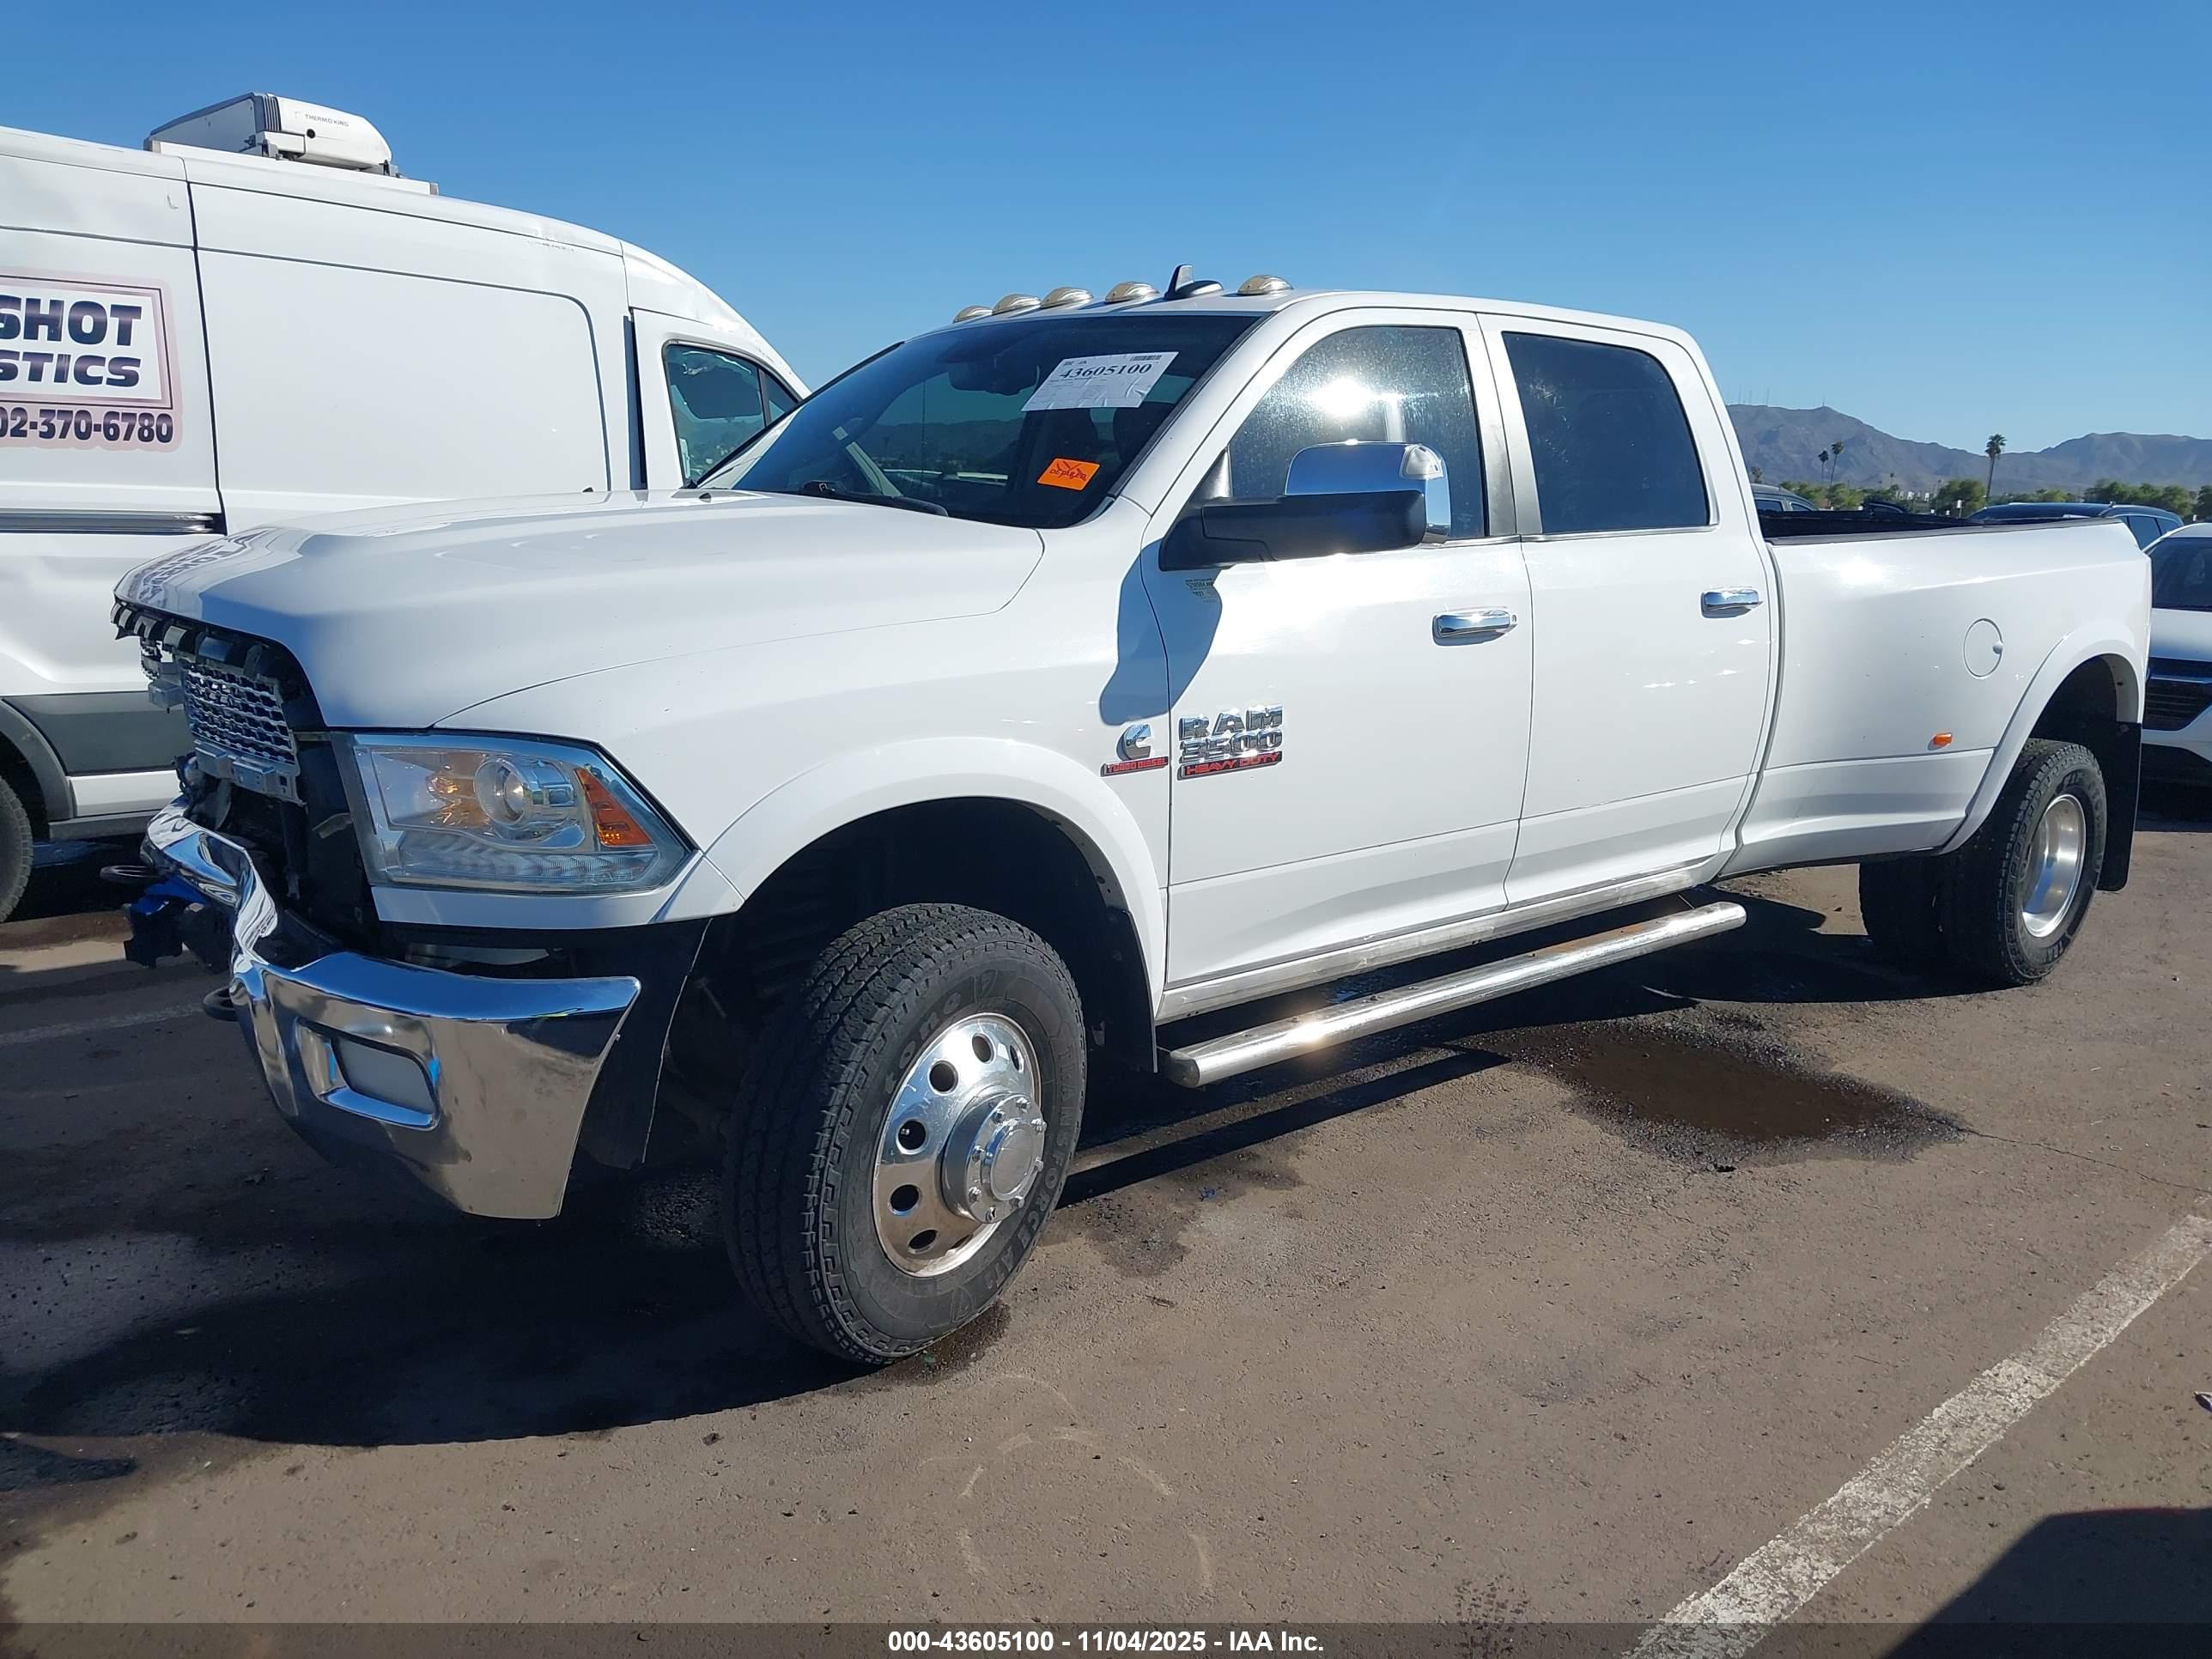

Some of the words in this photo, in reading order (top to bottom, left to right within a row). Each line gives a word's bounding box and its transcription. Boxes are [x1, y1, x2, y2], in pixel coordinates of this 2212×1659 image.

[305, 113, 332, 125] THERMO
[333, 119, 349, 128] KING
[1058, 363, 1152, 379] 43605100
[1178, 705, 1283, 740] RAM
[1178, 728, 1283, 763] 3500
[1186, 760, 1237, 775] HEAVY
[1239, 752, 1279, 767] DUTY
